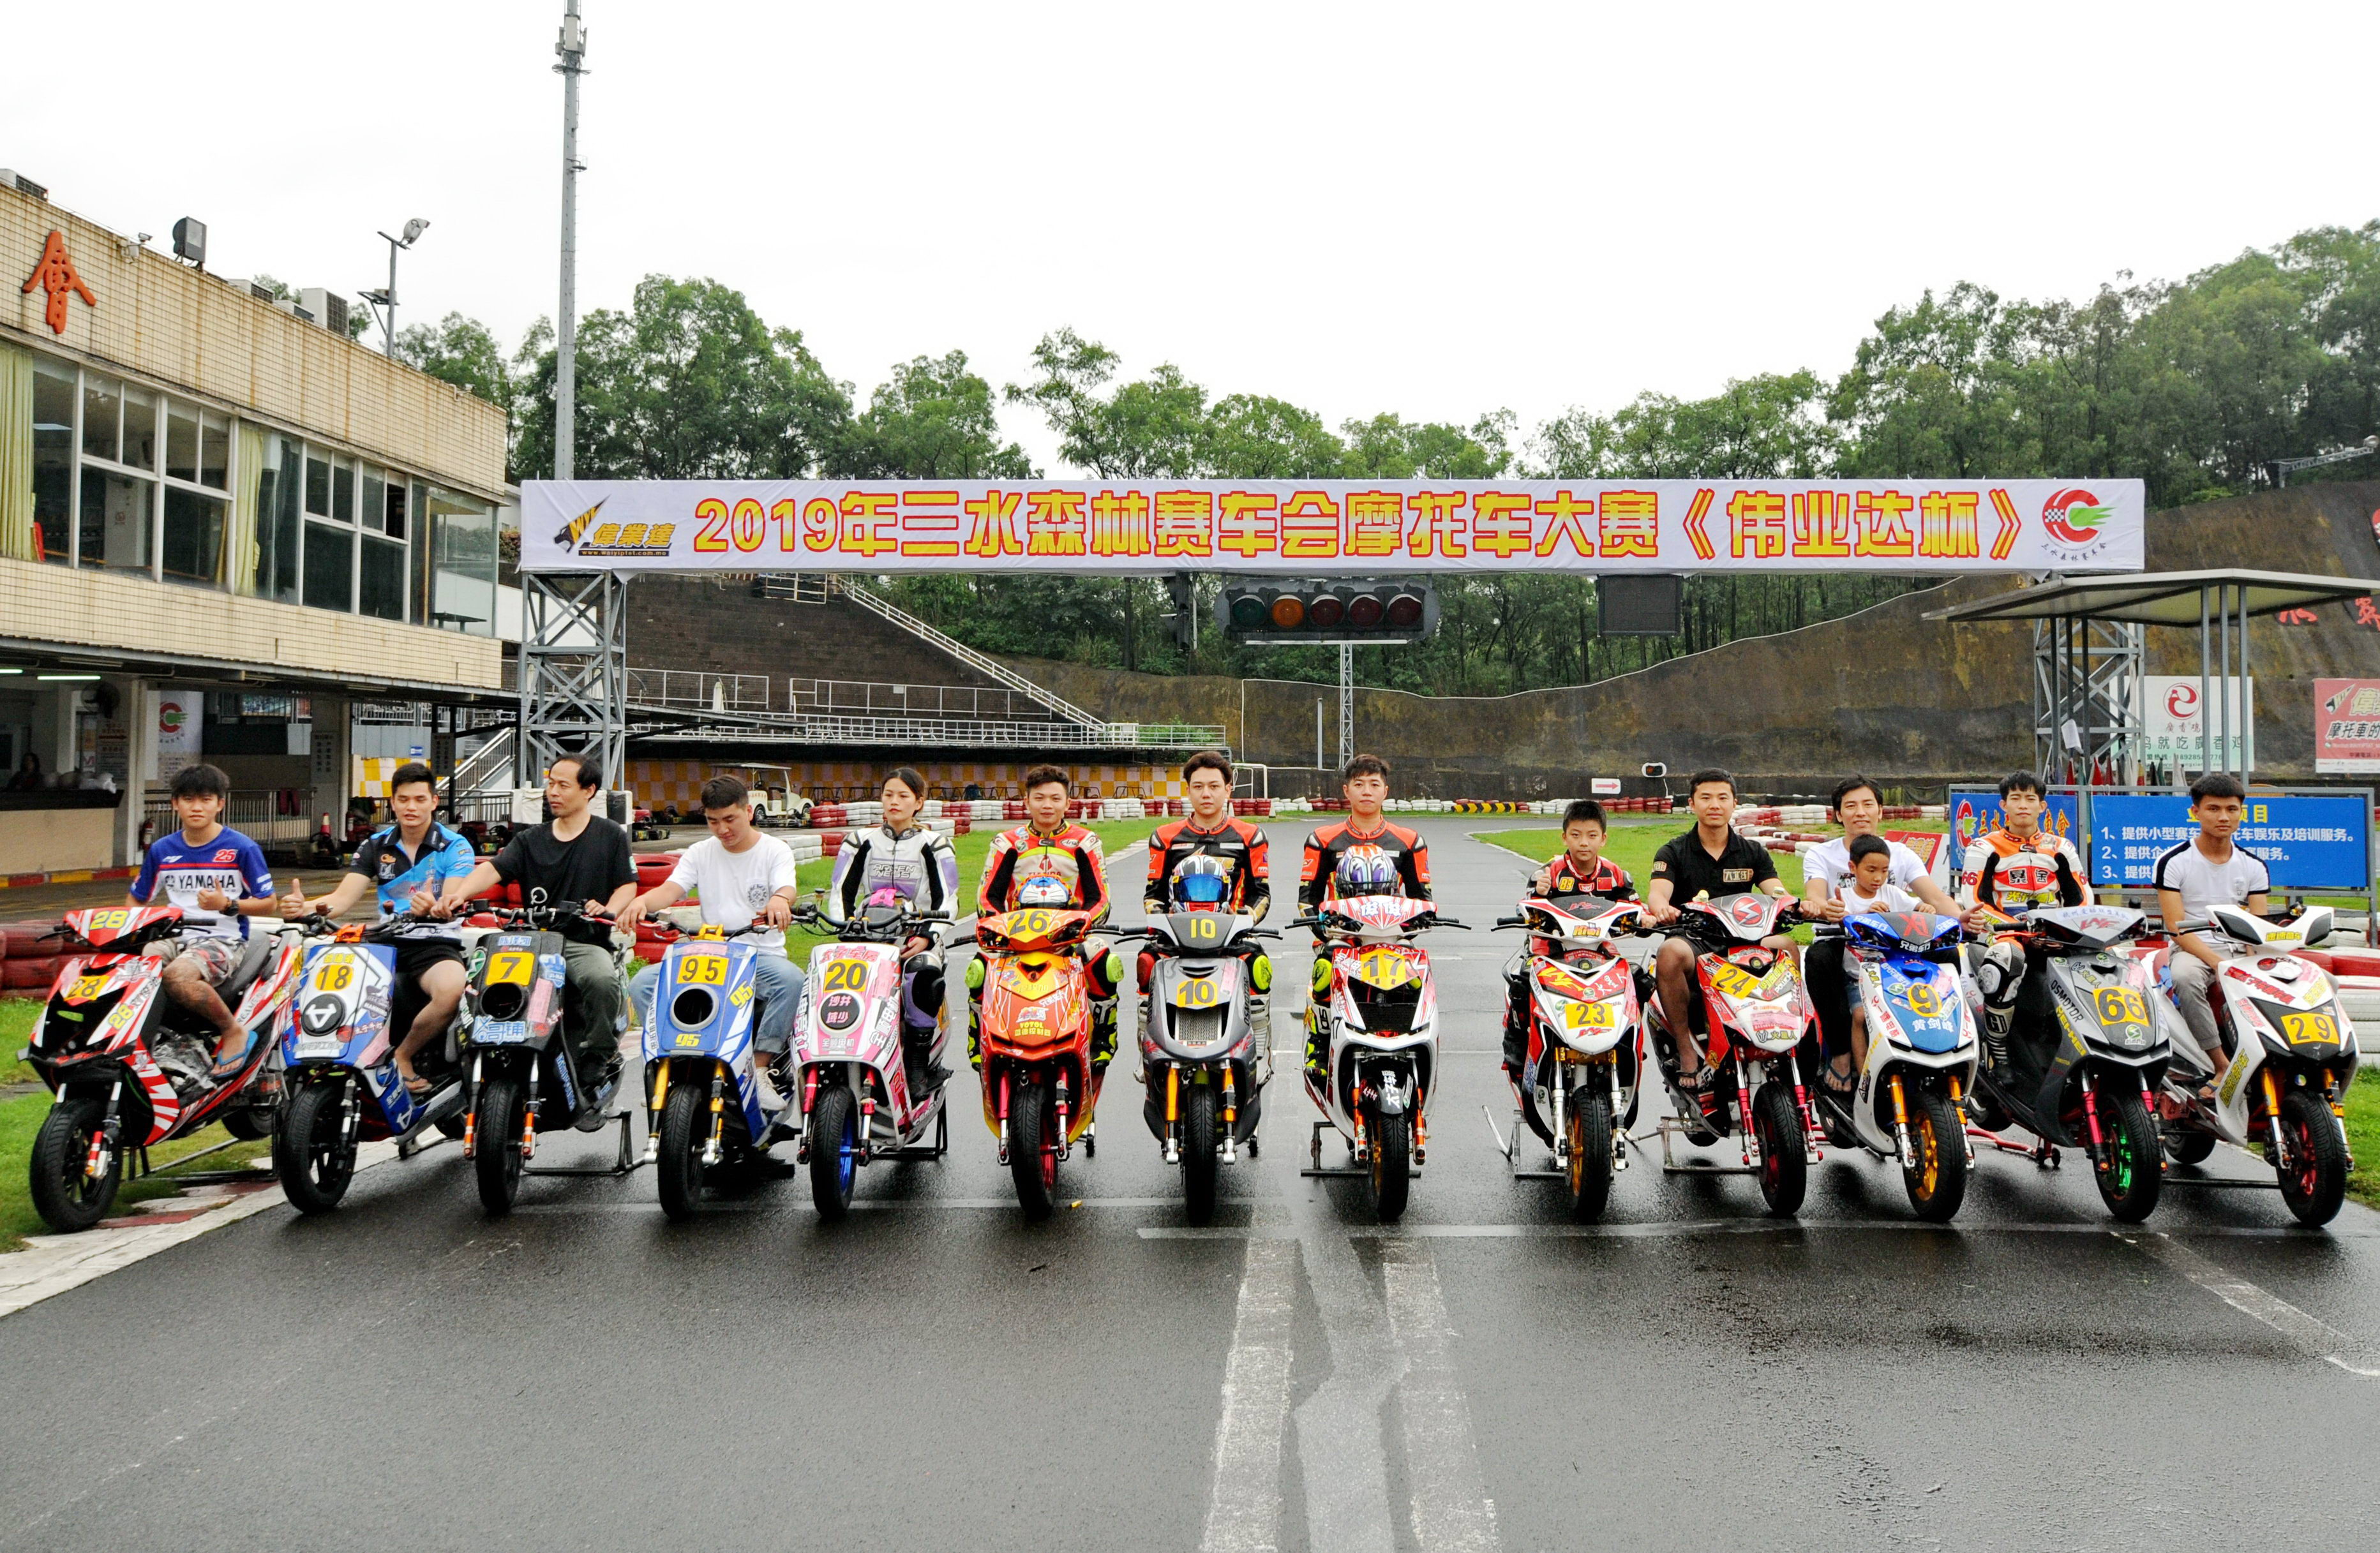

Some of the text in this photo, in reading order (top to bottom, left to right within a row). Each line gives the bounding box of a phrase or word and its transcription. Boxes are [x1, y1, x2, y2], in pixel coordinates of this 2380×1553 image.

[592, 523, 677, 546] 偉業達
[694, 488, 2022, 560] 2019年三水森林赛车会摩托车大赛《伟业达杯》
[213, 849, 238, 862] 25
[179, 875, 236, 889] YAMAHA
[89, 910, 129, 930] 28
[1009, 910, 1050, 935] 26
[1191, 918, 1216, 938] 10
[320, 965, 352, 990] 18
[500, 956, 521, 979] 7
[682, 958, 721, 982] 95
[825, 962, 869, 991] 20
[1363, 954, 1403, 985] 17
[66, 978, 101, 998] 28
[1179, 980, 1215, 1005] 10
[1716, 968, 1751, 995] 24
[729, 980, 754, 1010] 95
[1911, 985, 1939, 1013] 9
[2098, 988, 2146, 1023] 66
[108, 1003, 135, 1030] 28
[1576, 1004, 1606, 1025] 23
[675, 1032, 701, 1048] 95
[2290, 1016, 2330, 1041] 29
